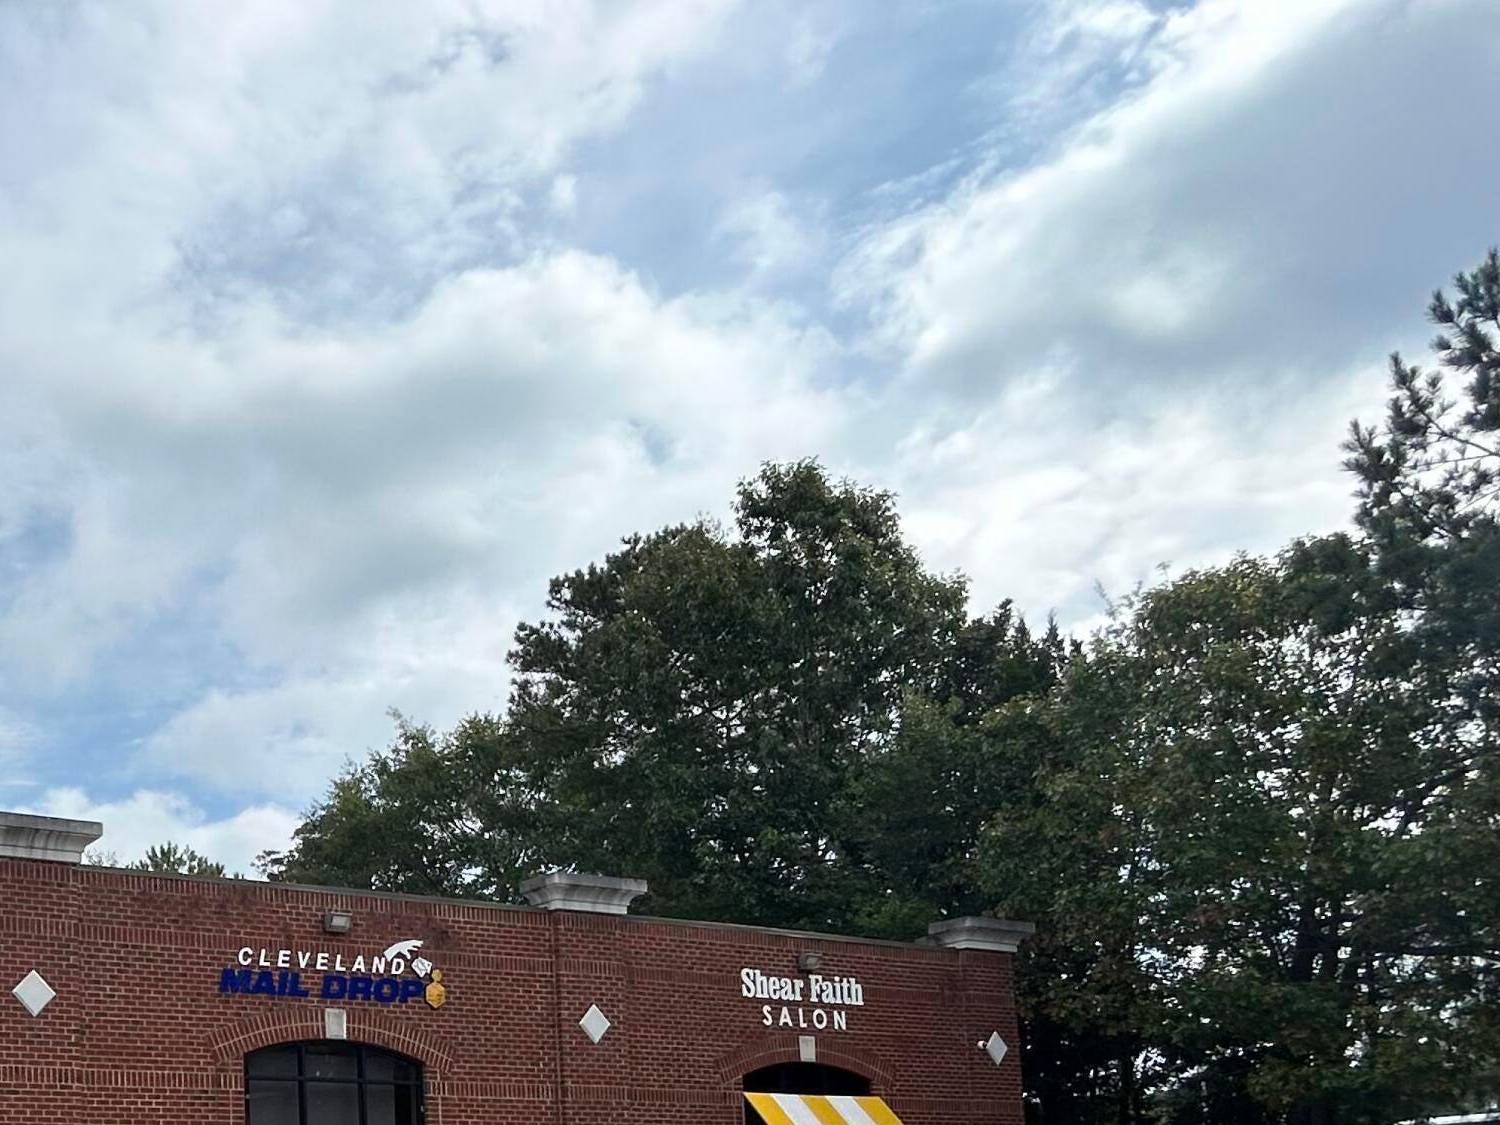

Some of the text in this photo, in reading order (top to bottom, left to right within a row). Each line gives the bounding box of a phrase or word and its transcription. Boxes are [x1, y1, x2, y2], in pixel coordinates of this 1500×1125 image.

[238, 946, 405, 975] CLEVELAND
[219, 968, 424, 1003] MAIL DROP
[741, 967, 865, 1006] Shear Faith
[762, 1005, 847, 1030] SALON
